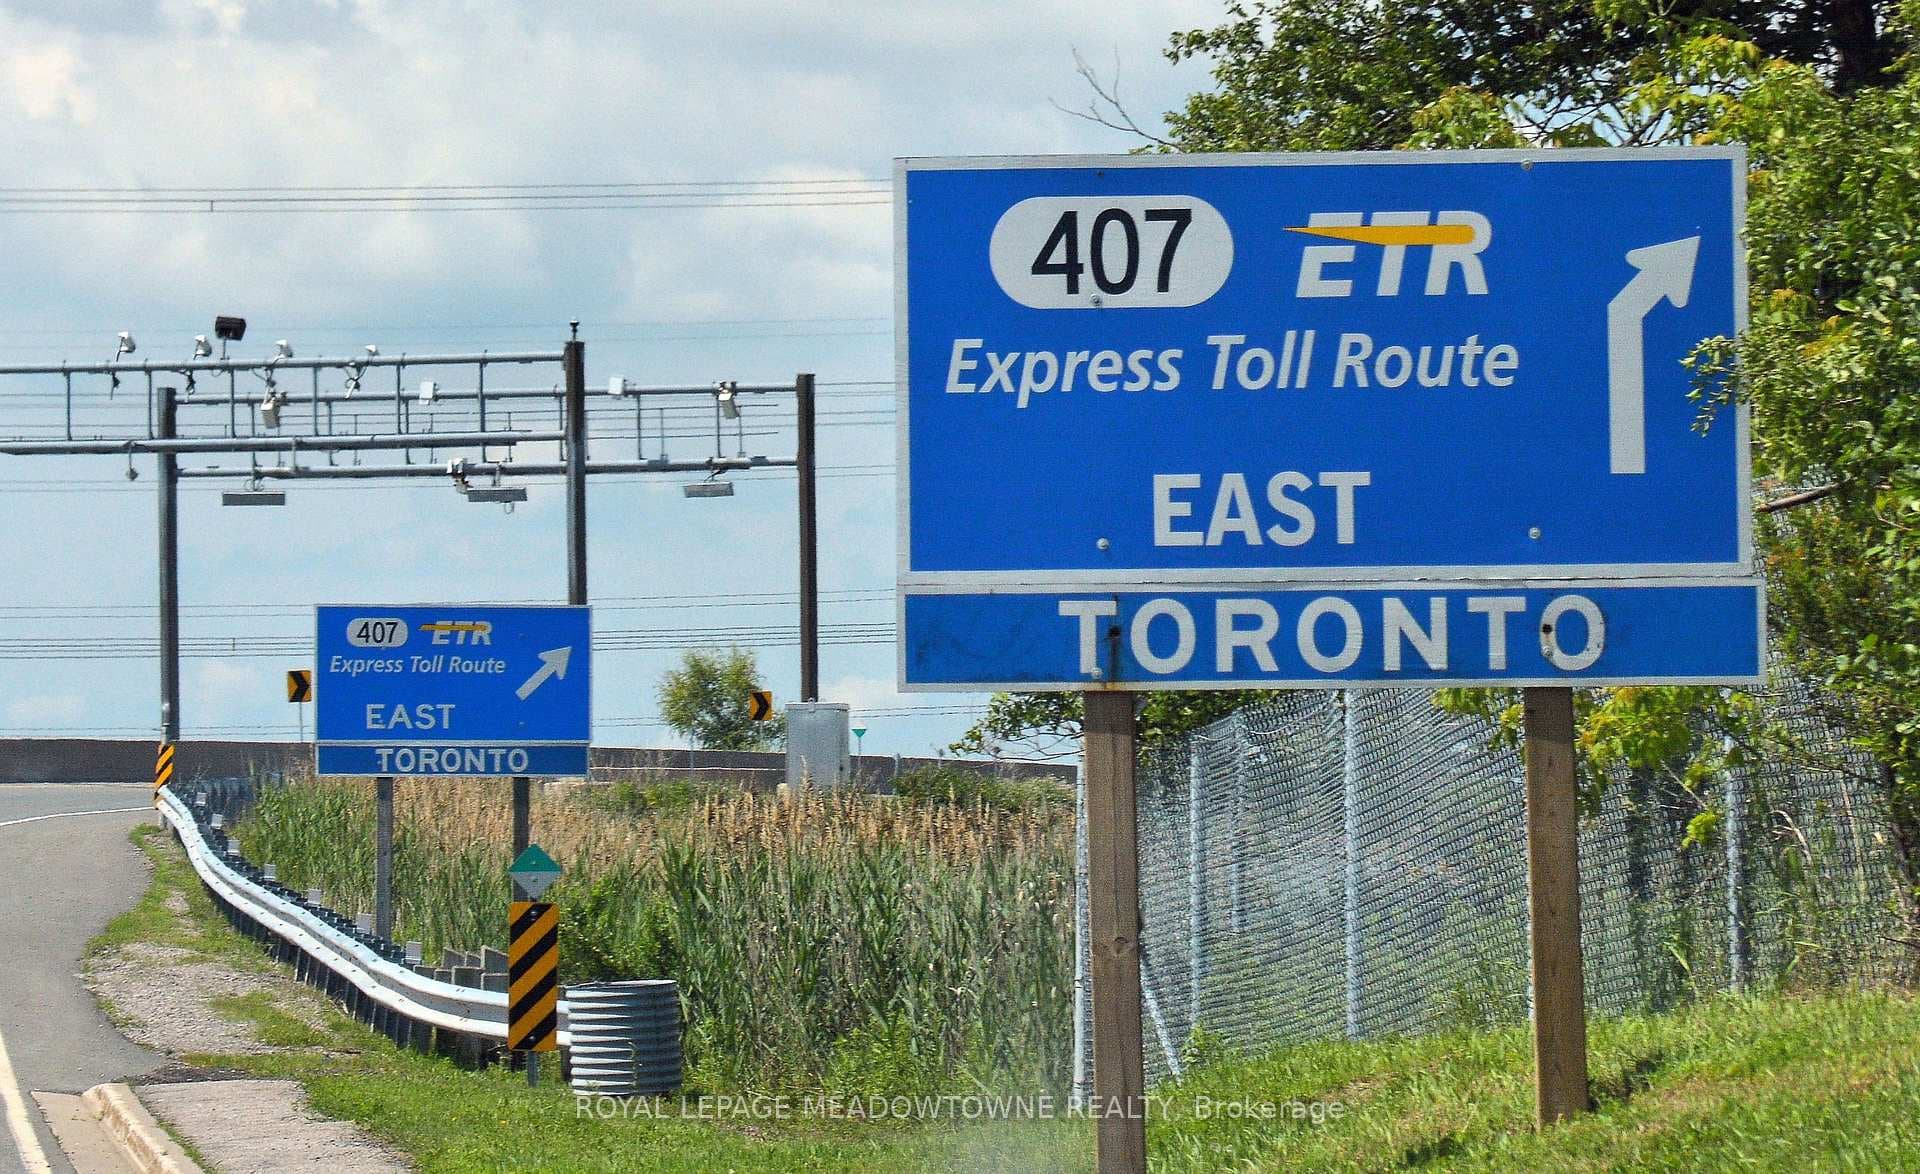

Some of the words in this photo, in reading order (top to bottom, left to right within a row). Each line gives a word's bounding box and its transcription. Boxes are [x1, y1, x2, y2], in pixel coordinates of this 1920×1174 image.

[1031, 207, 1192, 295] 407
[1294, 211, 1491, 298] ETR
[945, 338, 1184, 409] Express
[1206, 329, 1316, 391] Toll
[1333, 332, 1520, 389] Route
[1153, 471, 1371, 548] EAST
[356, 621, 398, 644] 407
[430, 621, 492, 645] ETR
[1058, 593, 1606, 675] TORONTO
[329, 655, 404, 677] Express
[410, 655, 443, 674] Toll
[448, 656, 506, 674] Route
[366, 703, 456, 730] EAST
[375, 748, 529, 773] TORONTO
